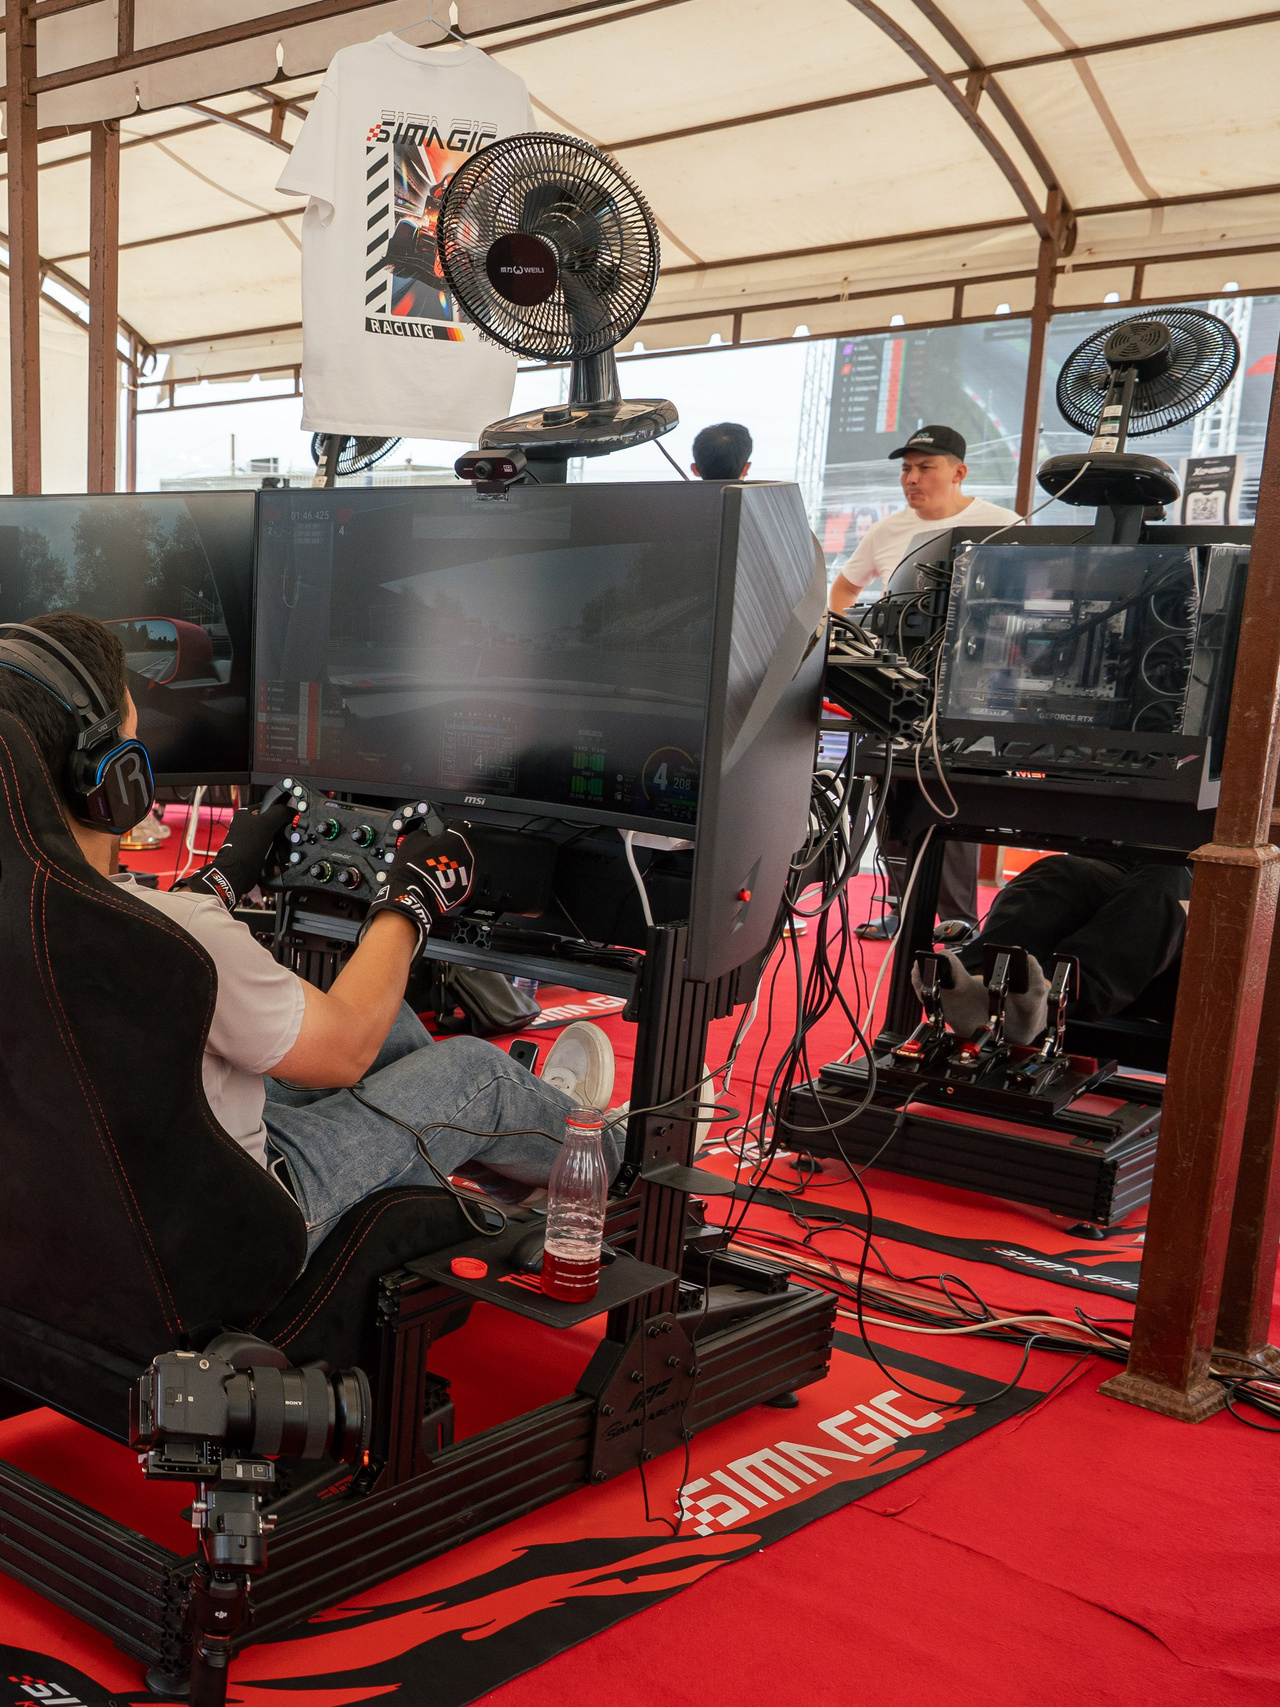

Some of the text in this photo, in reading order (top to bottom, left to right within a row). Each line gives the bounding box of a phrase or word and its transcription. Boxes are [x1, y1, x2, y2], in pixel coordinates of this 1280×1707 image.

[370, 319, 435, 339] RACING
[1077, 714, 1094, 723] RTX
[653, 762, 669, 791] 4
[673, 777, 691, 791] 208
[463, 796, 486, 806] msi
[673, 1389, 944, 1537] SIMAGIC
